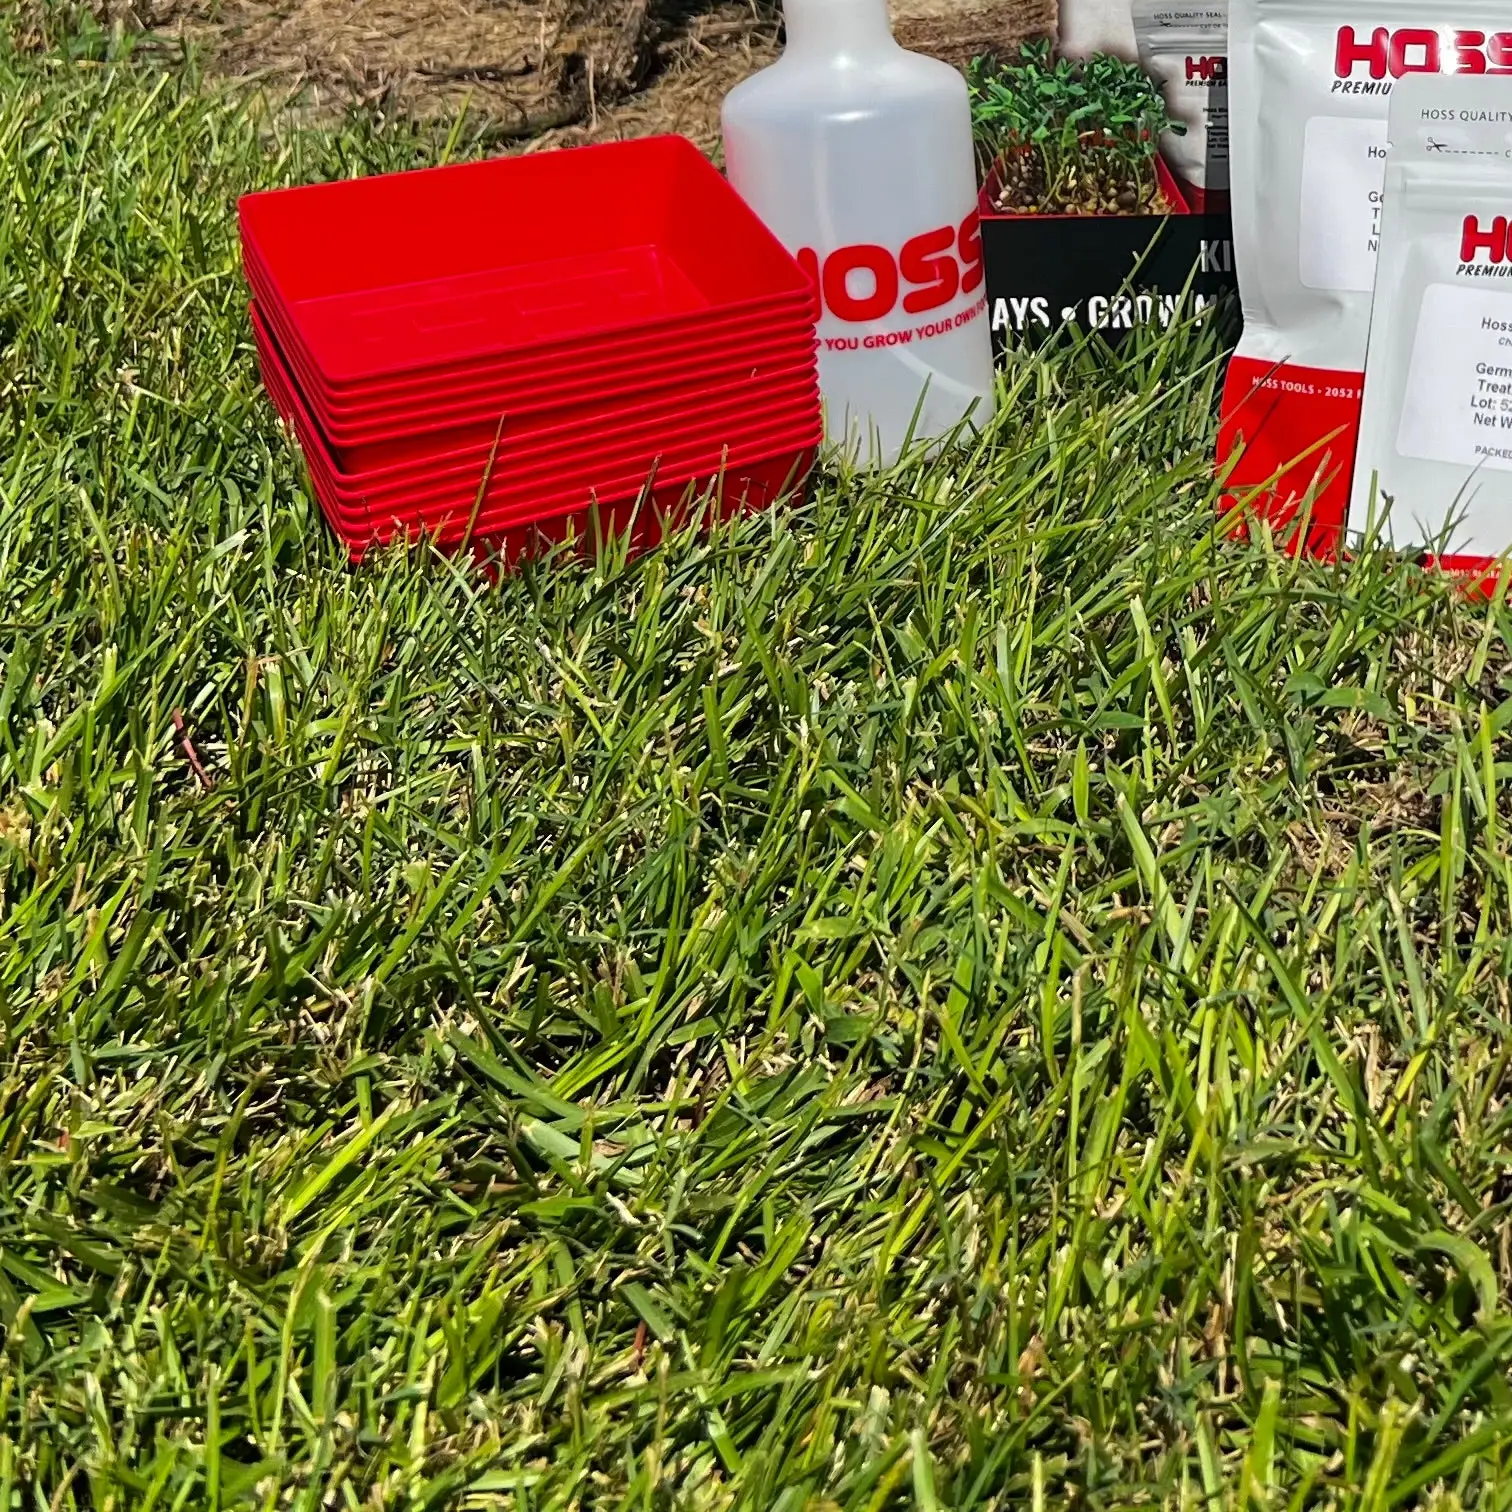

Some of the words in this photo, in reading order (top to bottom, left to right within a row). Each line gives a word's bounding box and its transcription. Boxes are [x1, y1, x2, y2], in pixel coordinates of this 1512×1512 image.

[1421, 109, 1455, 120] HOSS
[825, 338, 858, 351] YOU
[864, 330, 913, 348] GROW
[916, 319, 953, 339] YOUR
[1281, 381, 1314, 395] TOOLS
[1471, 396, 1497, 411] Lot:
[1473, 414, 1496, 428] Net
